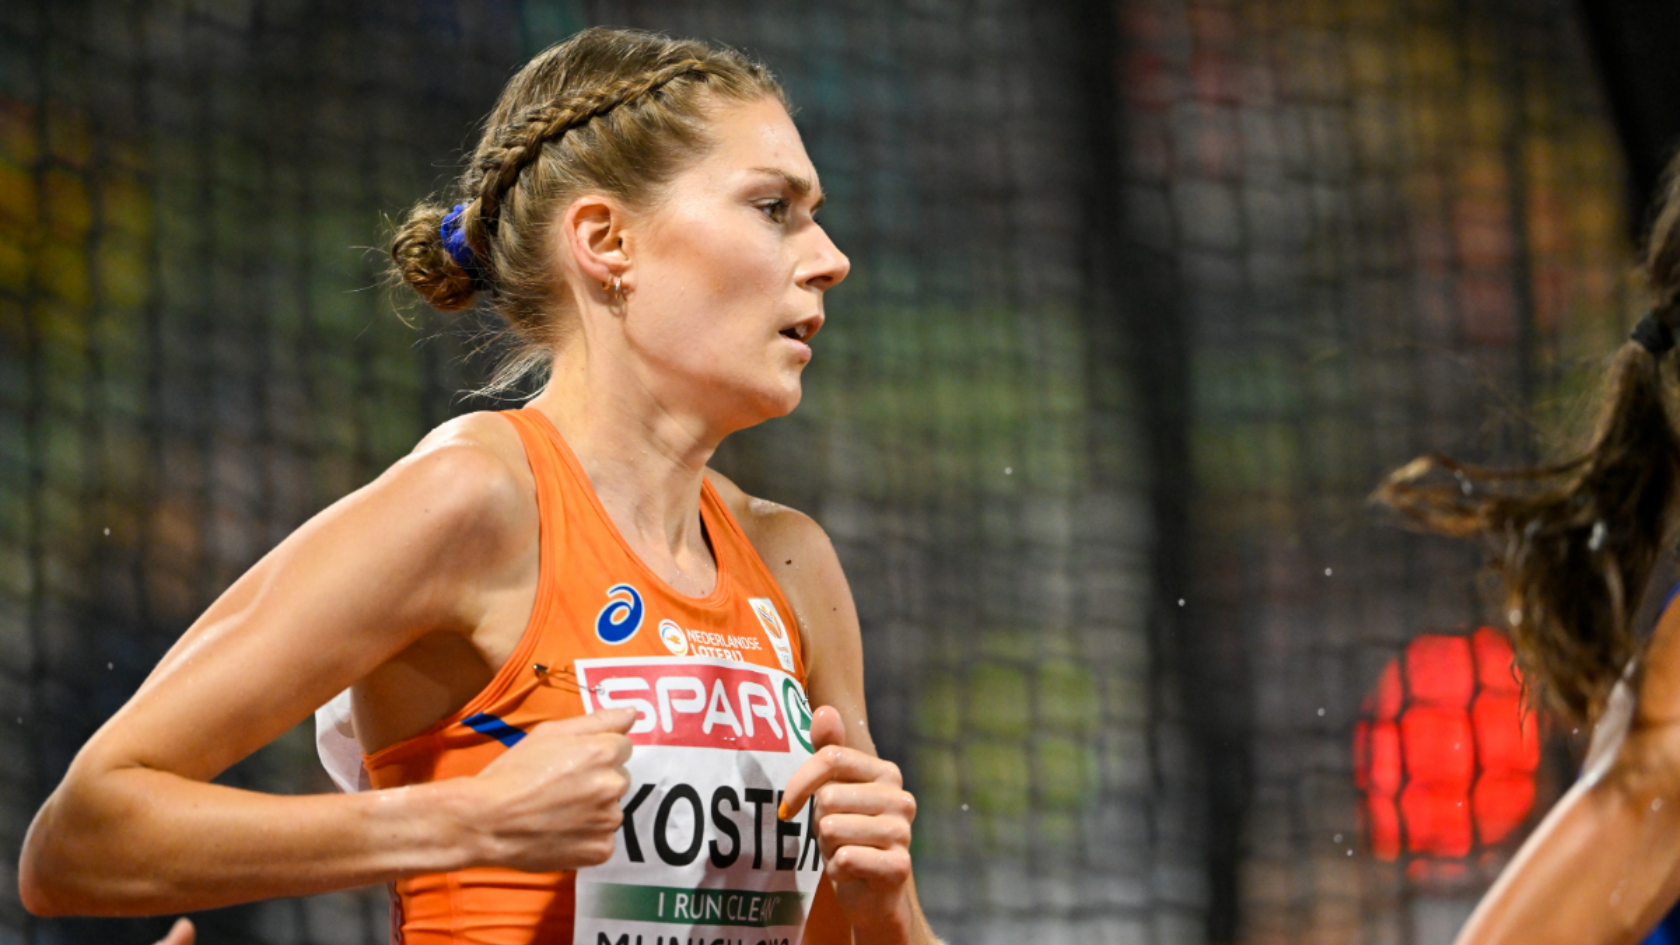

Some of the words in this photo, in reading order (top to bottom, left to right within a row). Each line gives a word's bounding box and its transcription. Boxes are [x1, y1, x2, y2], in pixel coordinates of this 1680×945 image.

[686, 628, 762, 650] NEDERLANDSE
[597, 676, 783, 740] SPAR
[658, 892, 665, 917] I
[674, 893, 722, 919] RUN
